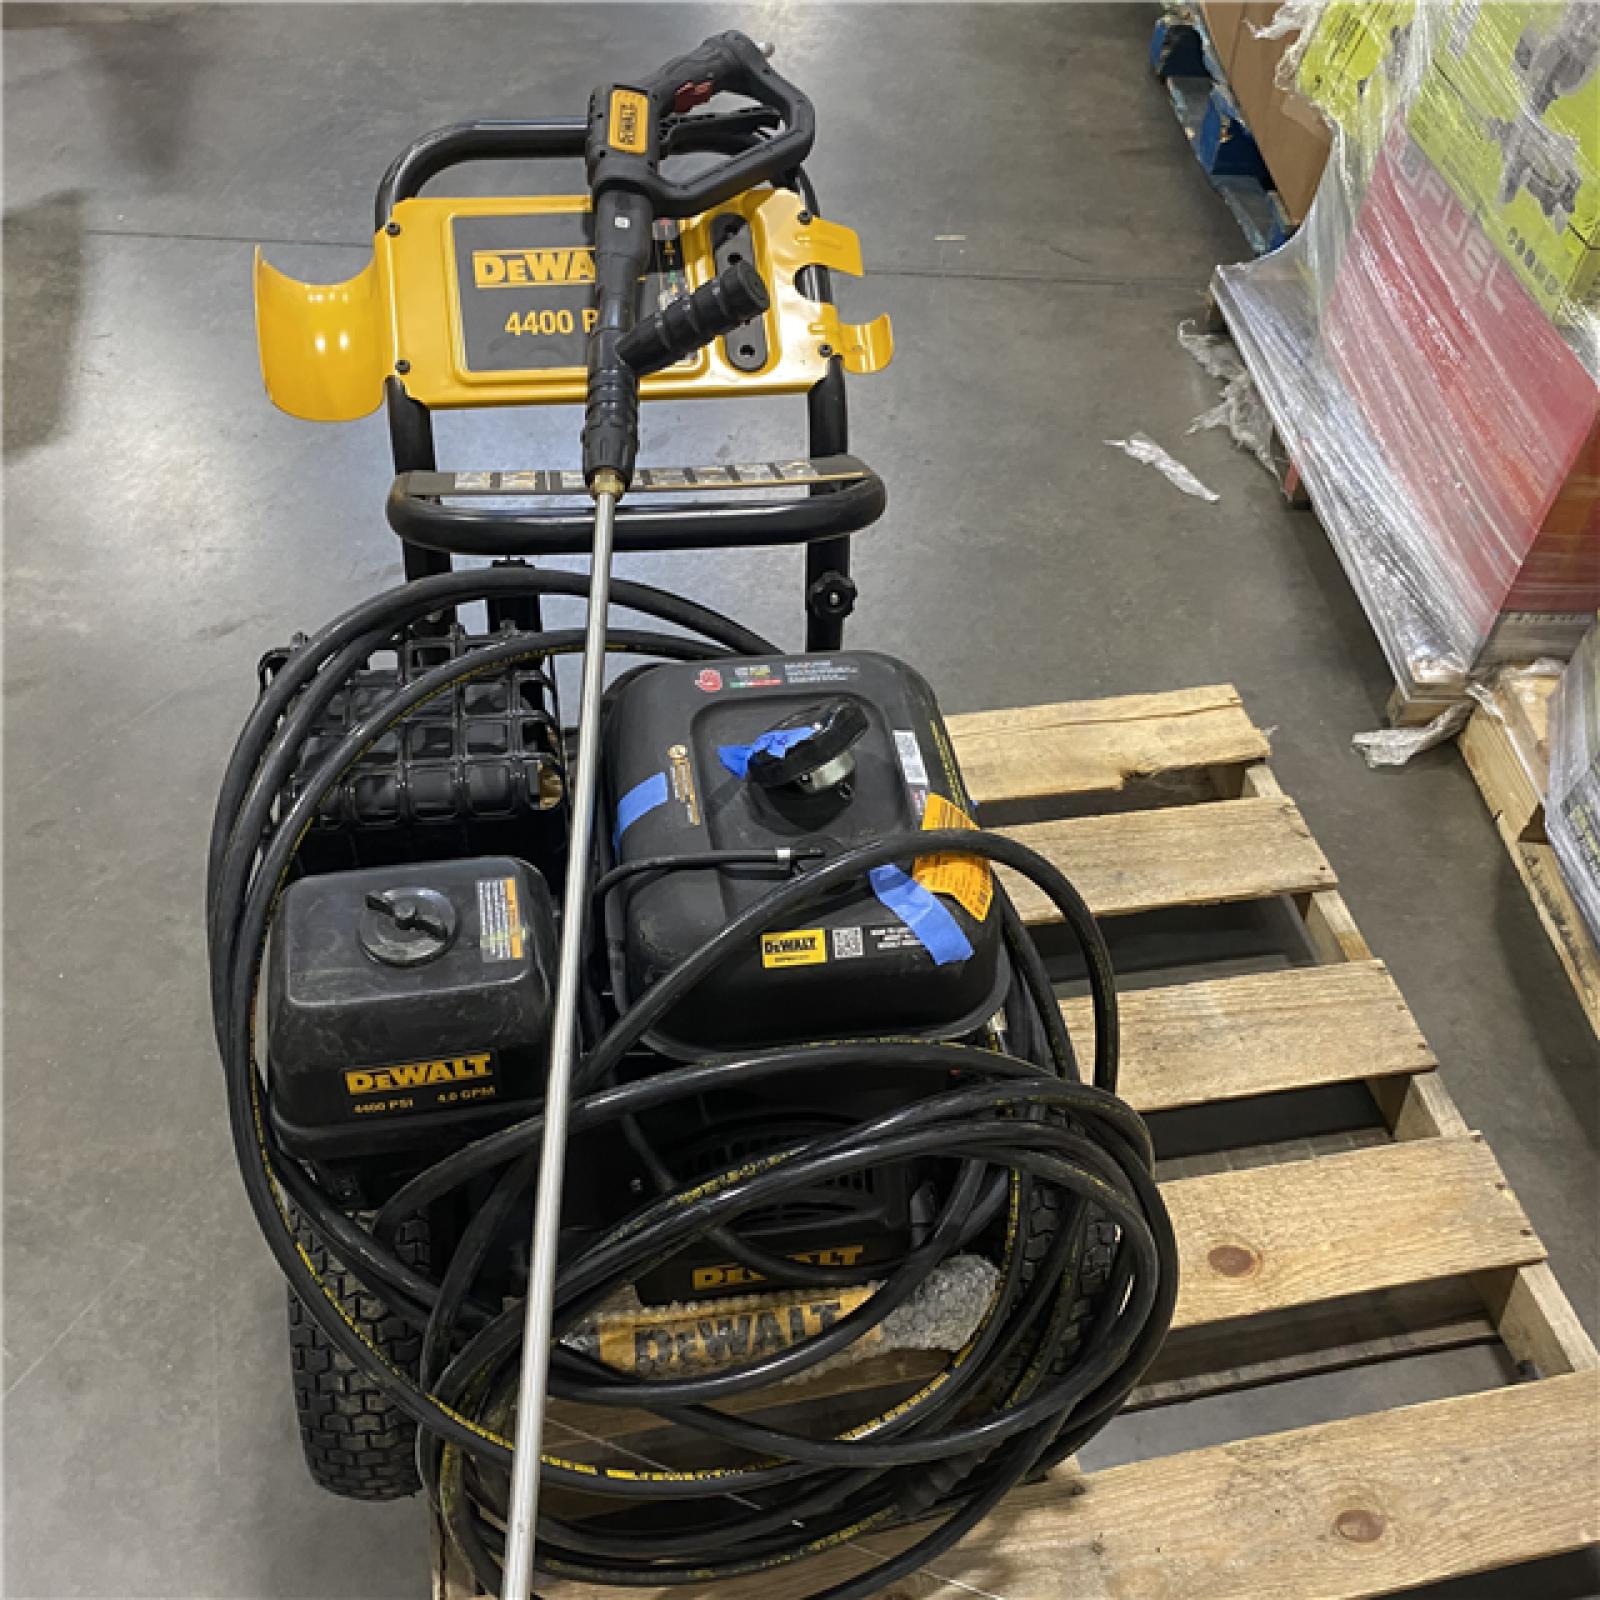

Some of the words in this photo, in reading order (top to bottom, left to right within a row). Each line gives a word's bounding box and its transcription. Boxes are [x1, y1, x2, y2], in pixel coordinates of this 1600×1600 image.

[504, 310, 575, 336] 4400
[345, 1052, 491, 1095] DEWALT
[634, 1302, 842, 1376] DEWALT
